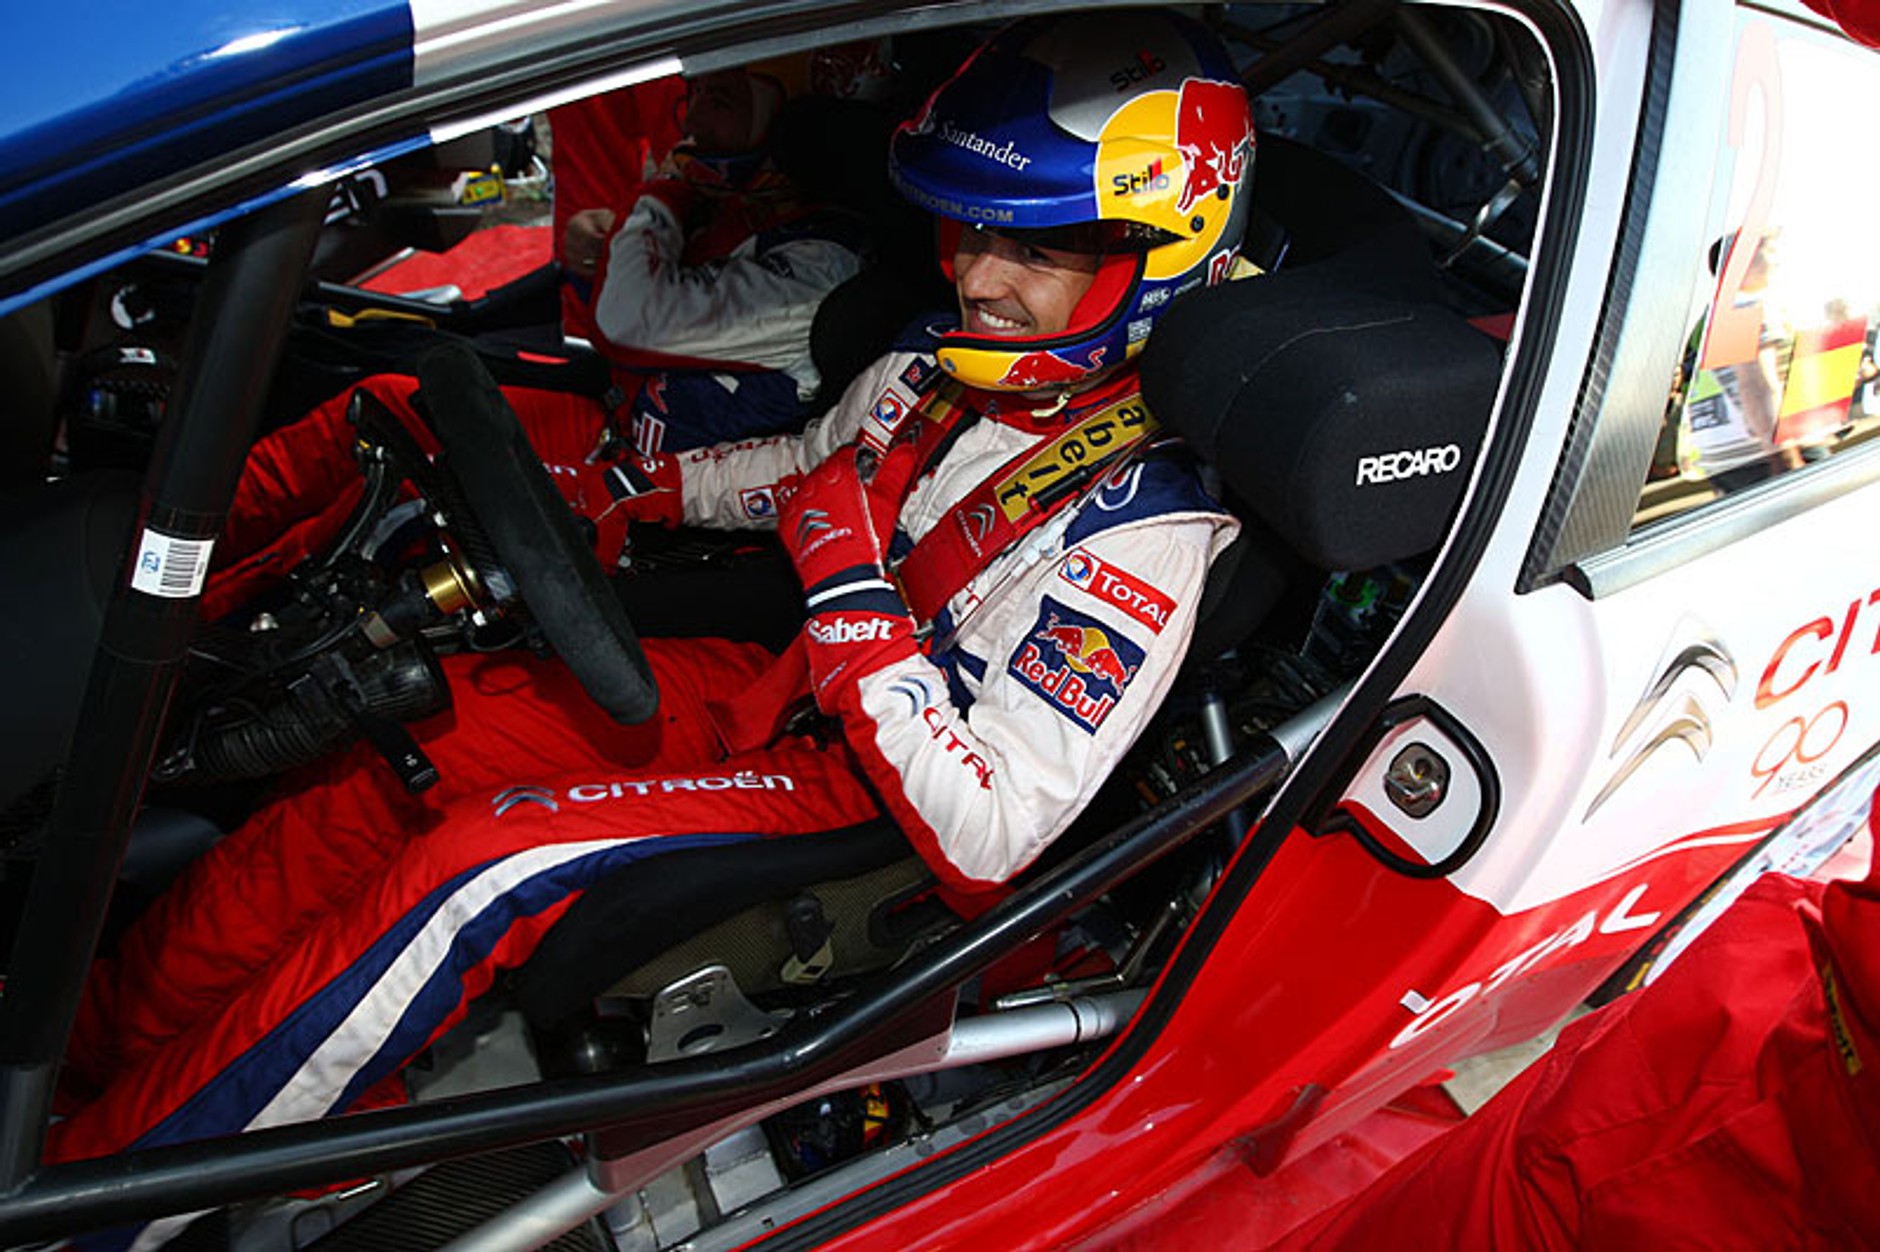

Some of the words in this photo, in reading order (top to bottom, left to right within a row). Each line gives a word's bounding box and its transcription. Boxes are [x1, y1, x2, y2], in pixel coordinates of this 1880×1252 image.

[1109, 48, 1167, 93] Stilo
[937, 119, 1032, 172] Santander
[1112, 157, 1170, 197] Stilo
[1356, 445, 1460, 486] RECARO
[1100, 570, 1168, 627] TOTAL
[807, 617, 896, 645] Sabelt
